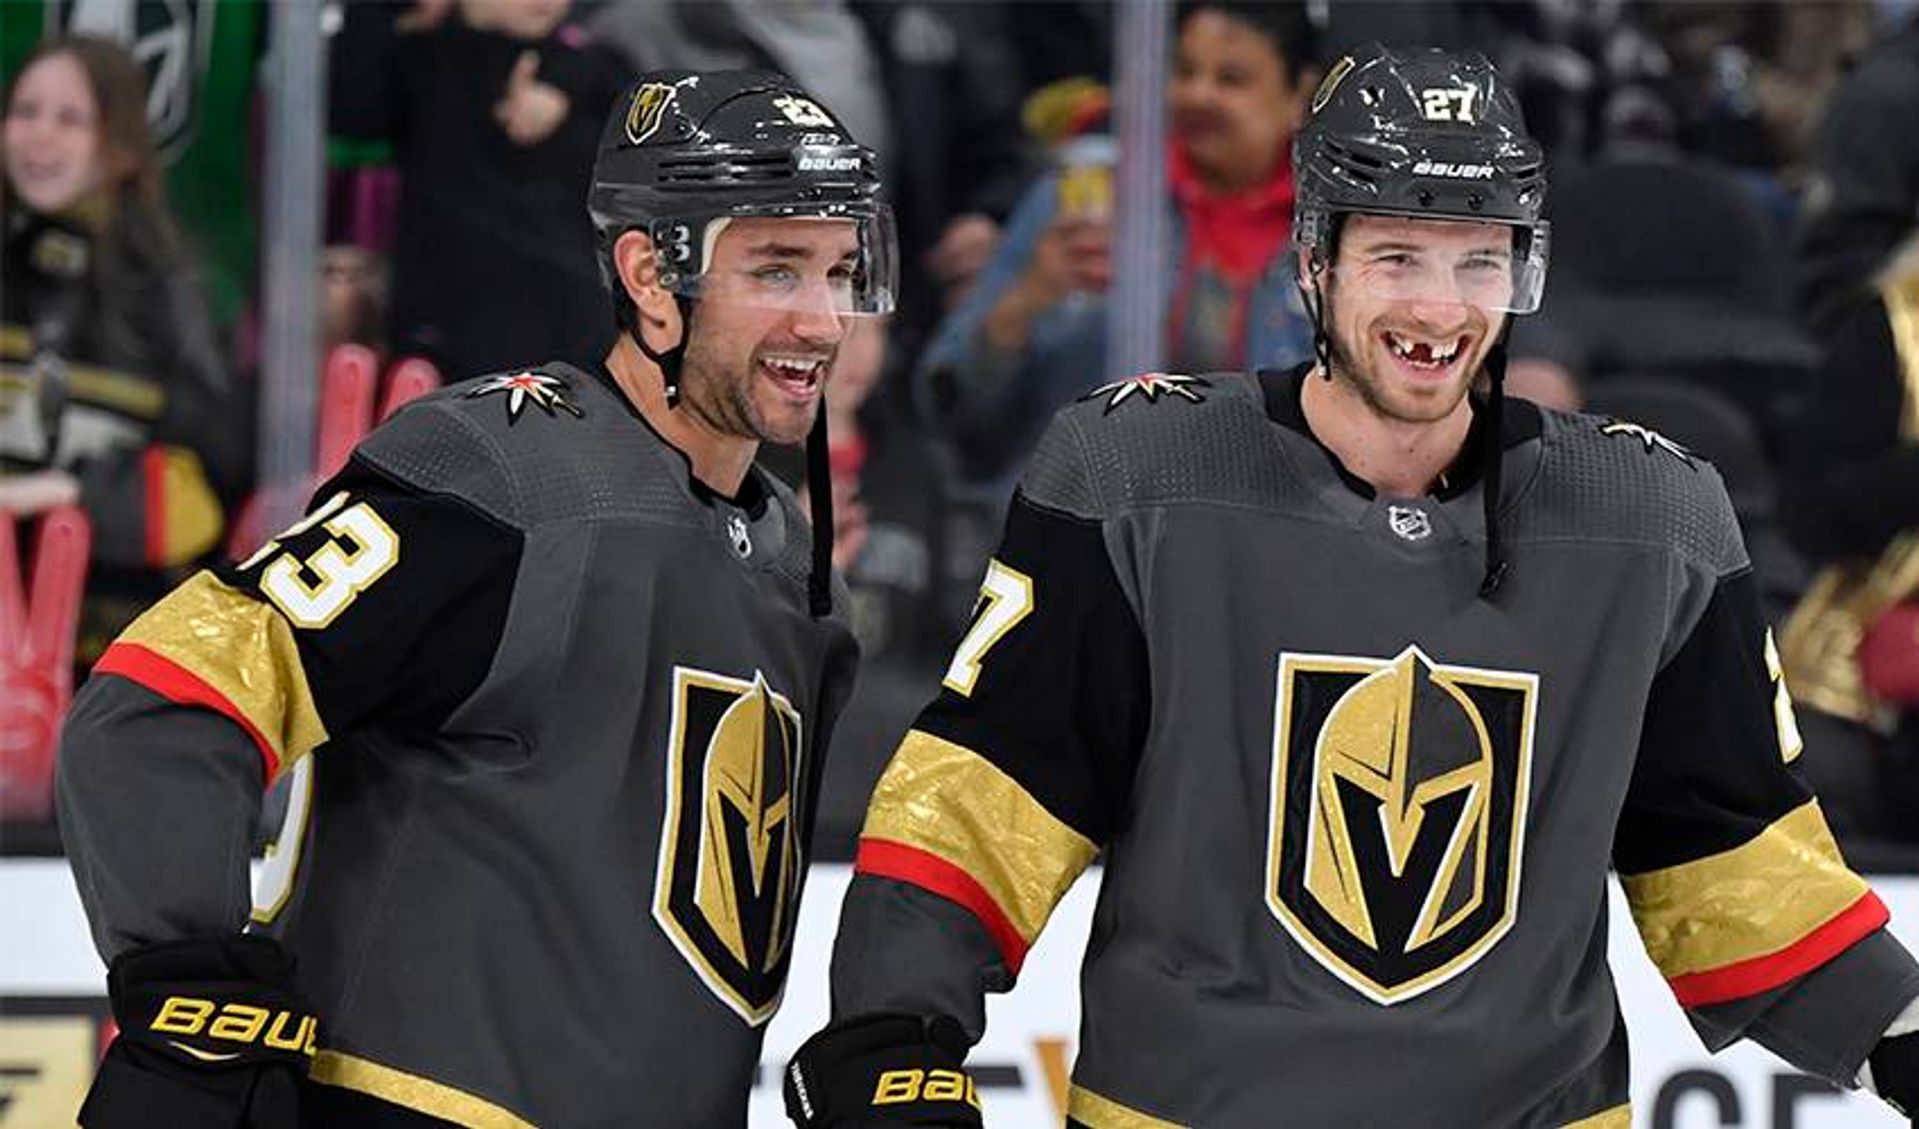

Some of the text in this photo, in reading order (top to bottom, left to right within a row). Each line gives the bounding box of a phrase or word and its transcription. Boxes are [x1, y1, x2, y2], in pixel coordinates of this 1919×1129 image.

[1422, 81, 1476, 125] 27
[235, 490, 400, 630] 3
[942, 558, 1035, 698] 7
